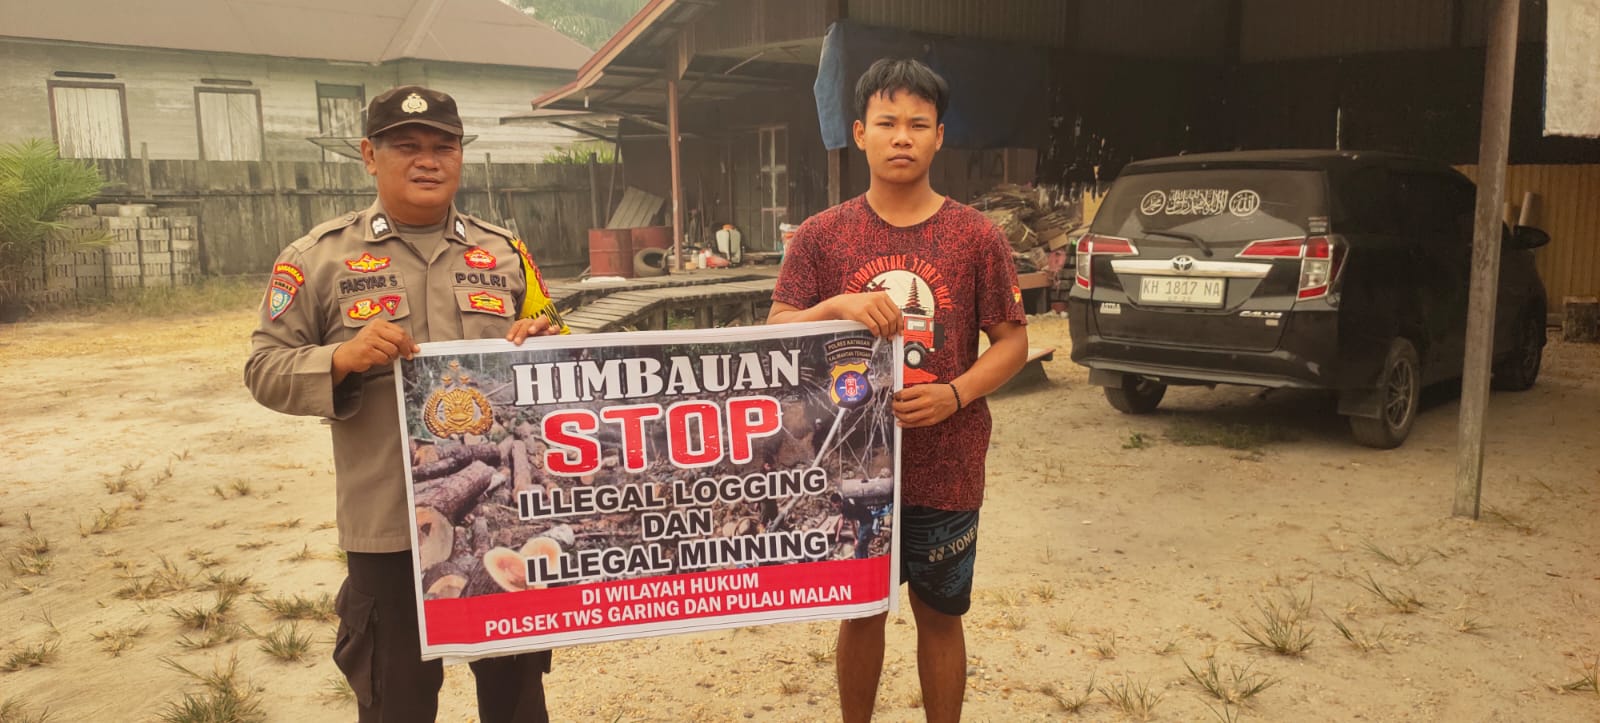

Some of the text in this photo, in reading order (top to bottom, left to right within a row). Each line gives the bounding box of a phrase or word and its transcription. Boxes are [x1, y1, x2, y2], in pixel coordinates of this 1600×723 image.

[339, 274, 398, 294] FAISYAR S
[455, 272, 506, 287] POLRI
[910, 258, 942, 284] START
[1143, 279, 1220, 297] KH 1817 NA
[512, 349, 801, 406] HIMBAUAN
[541, 395, 783, 477] STOP
[518, 467, 827, 519] ILLEGAL LOGGING
[642, 508, 714, 541] DAN
[526, 531, 829, 584] ILLEGAL MINNING
[582, 572, 759, 605] DI WILAYAH HUKUM
[485, 584, 852, 637] POLSEK TWS GARING DAN PULAU MALAN
